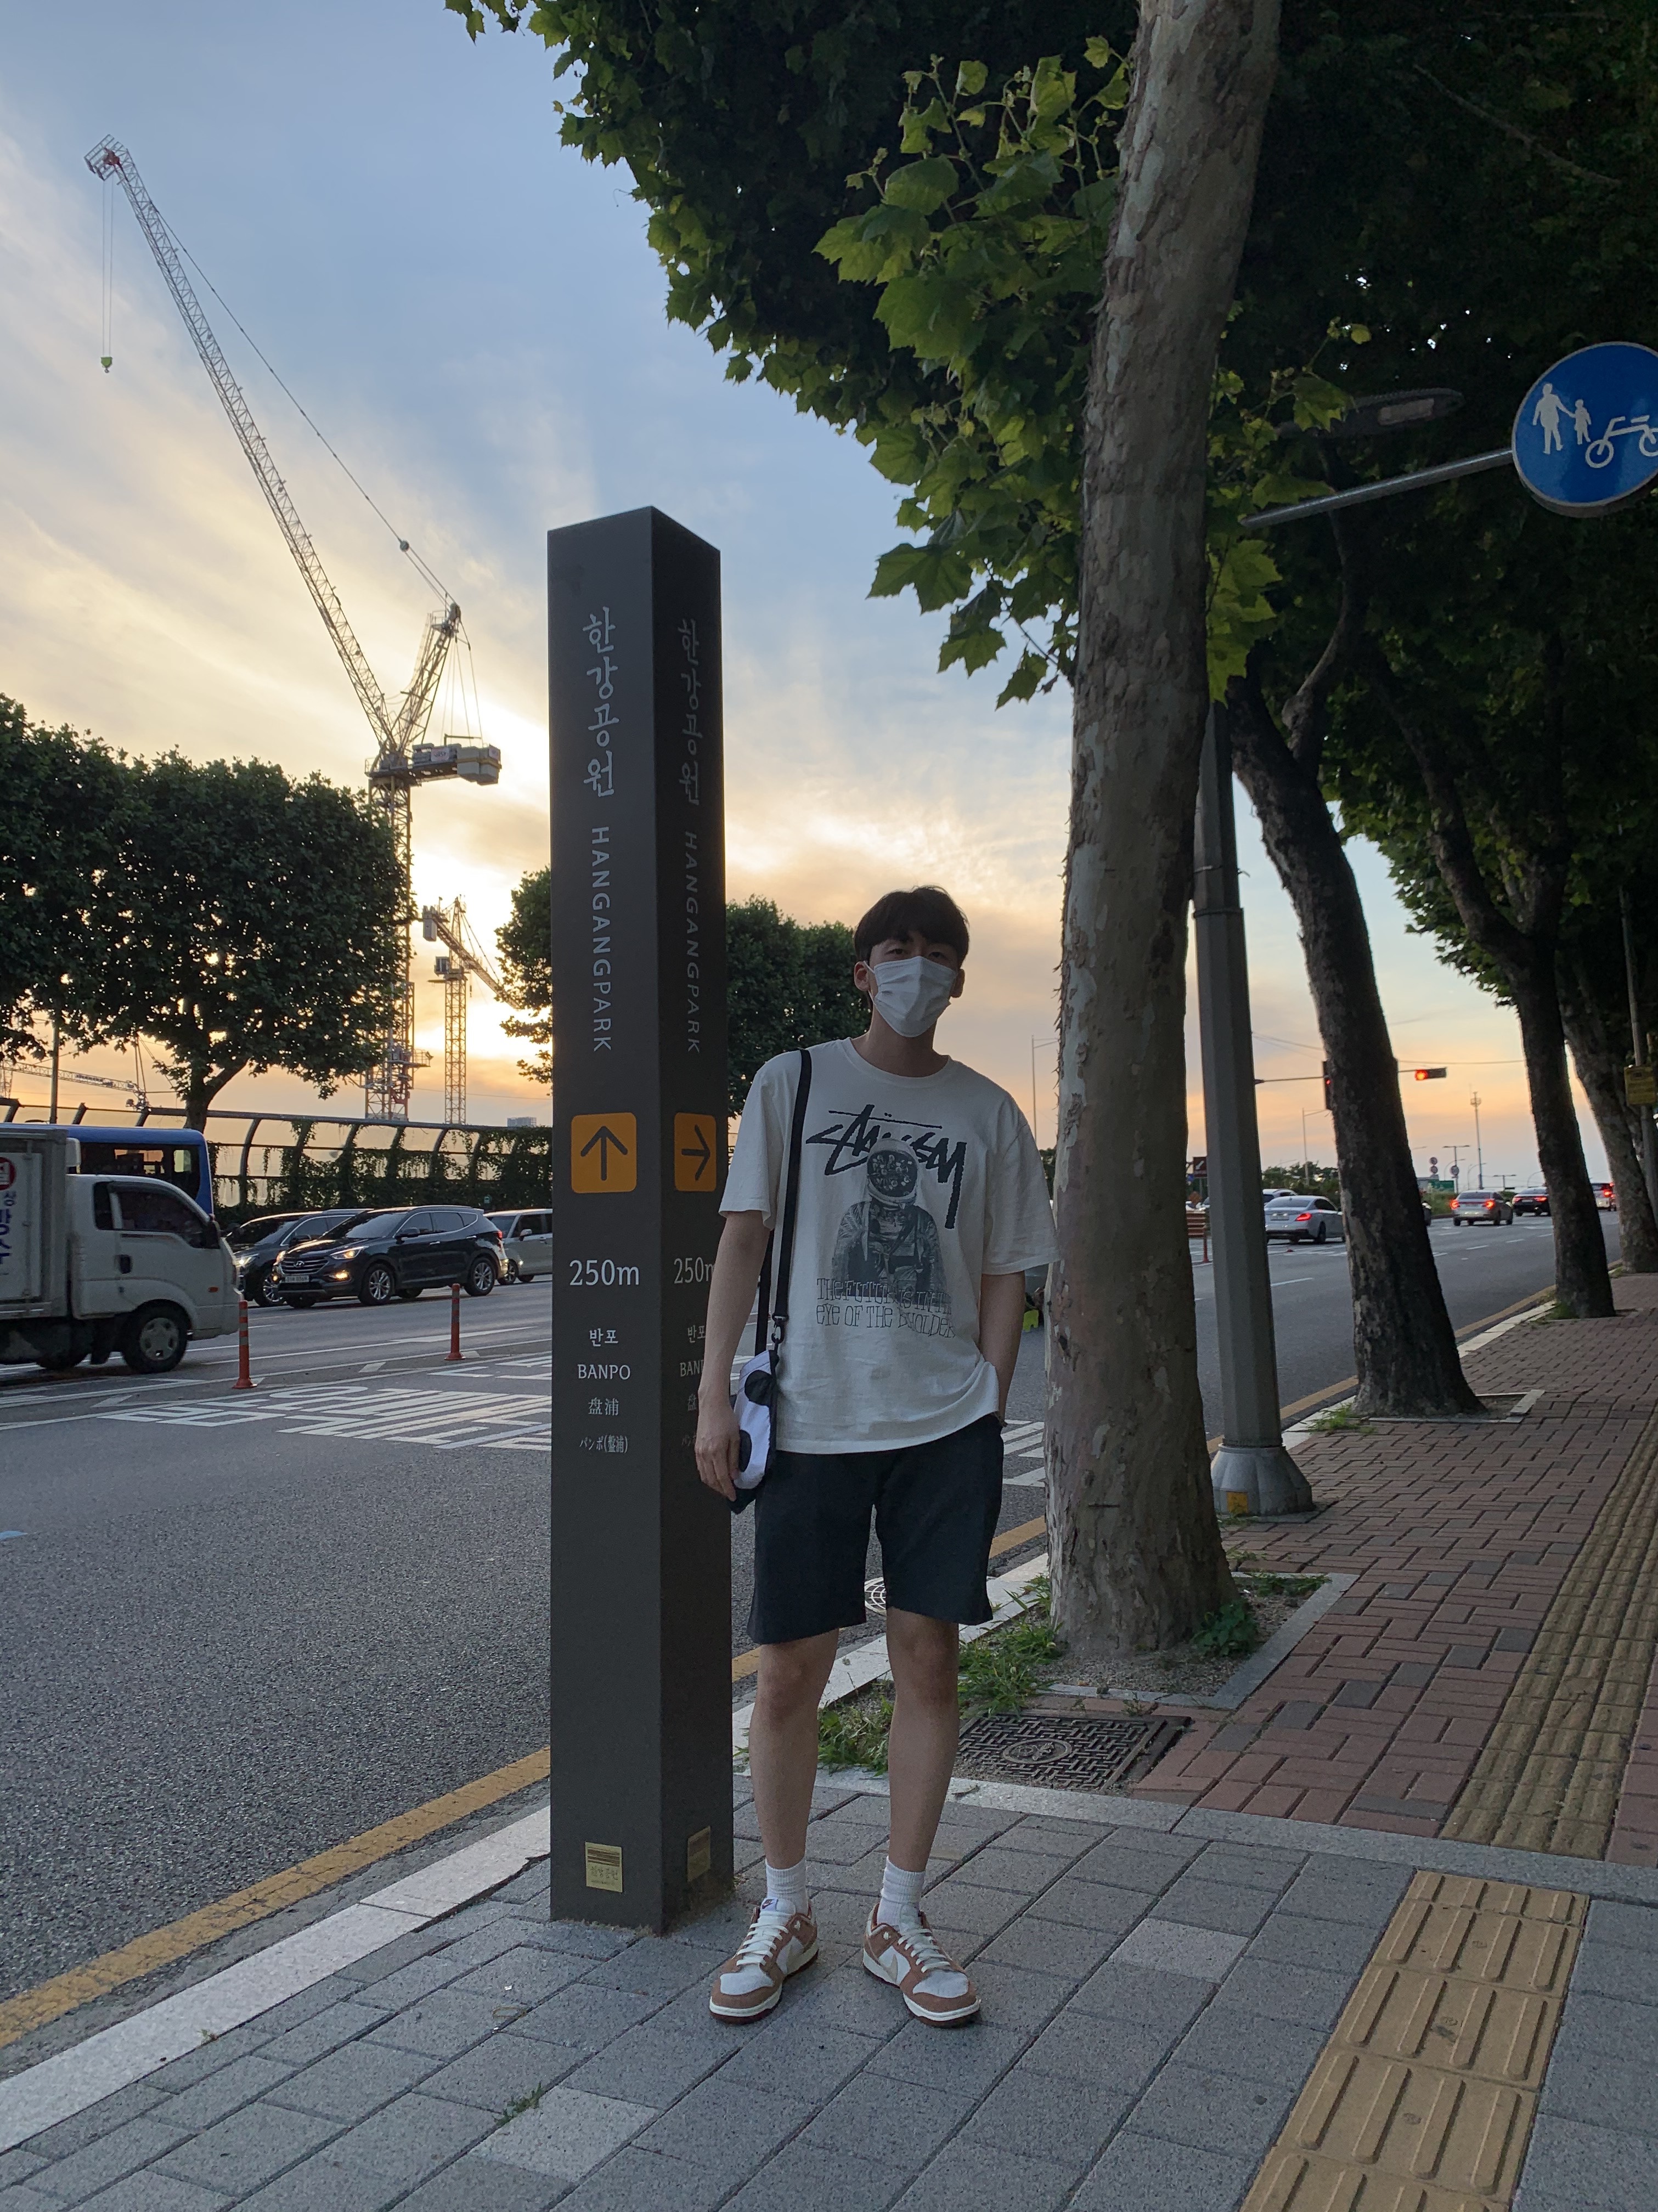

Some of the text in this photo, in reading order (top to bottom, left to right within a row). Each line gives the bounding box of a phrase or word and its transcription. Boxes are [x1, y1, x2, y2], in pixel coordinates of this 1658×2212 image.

[583, 606, 619, 797] 한강공원
[678, 618, 703, 806] 한강공원
[592, 826, 612, 1052] HANGANGPARK
[685, 831, 700, 1053] HANGANGPARK
[569, 1259, 640, 1285] 250m
[844, 1305, 864, 1327] OF
[589, 1328, 618, 1347] 반포
[577, 1364, 631, 1380] BANPO
[588, 1397, 619, 1416] 盘浦
